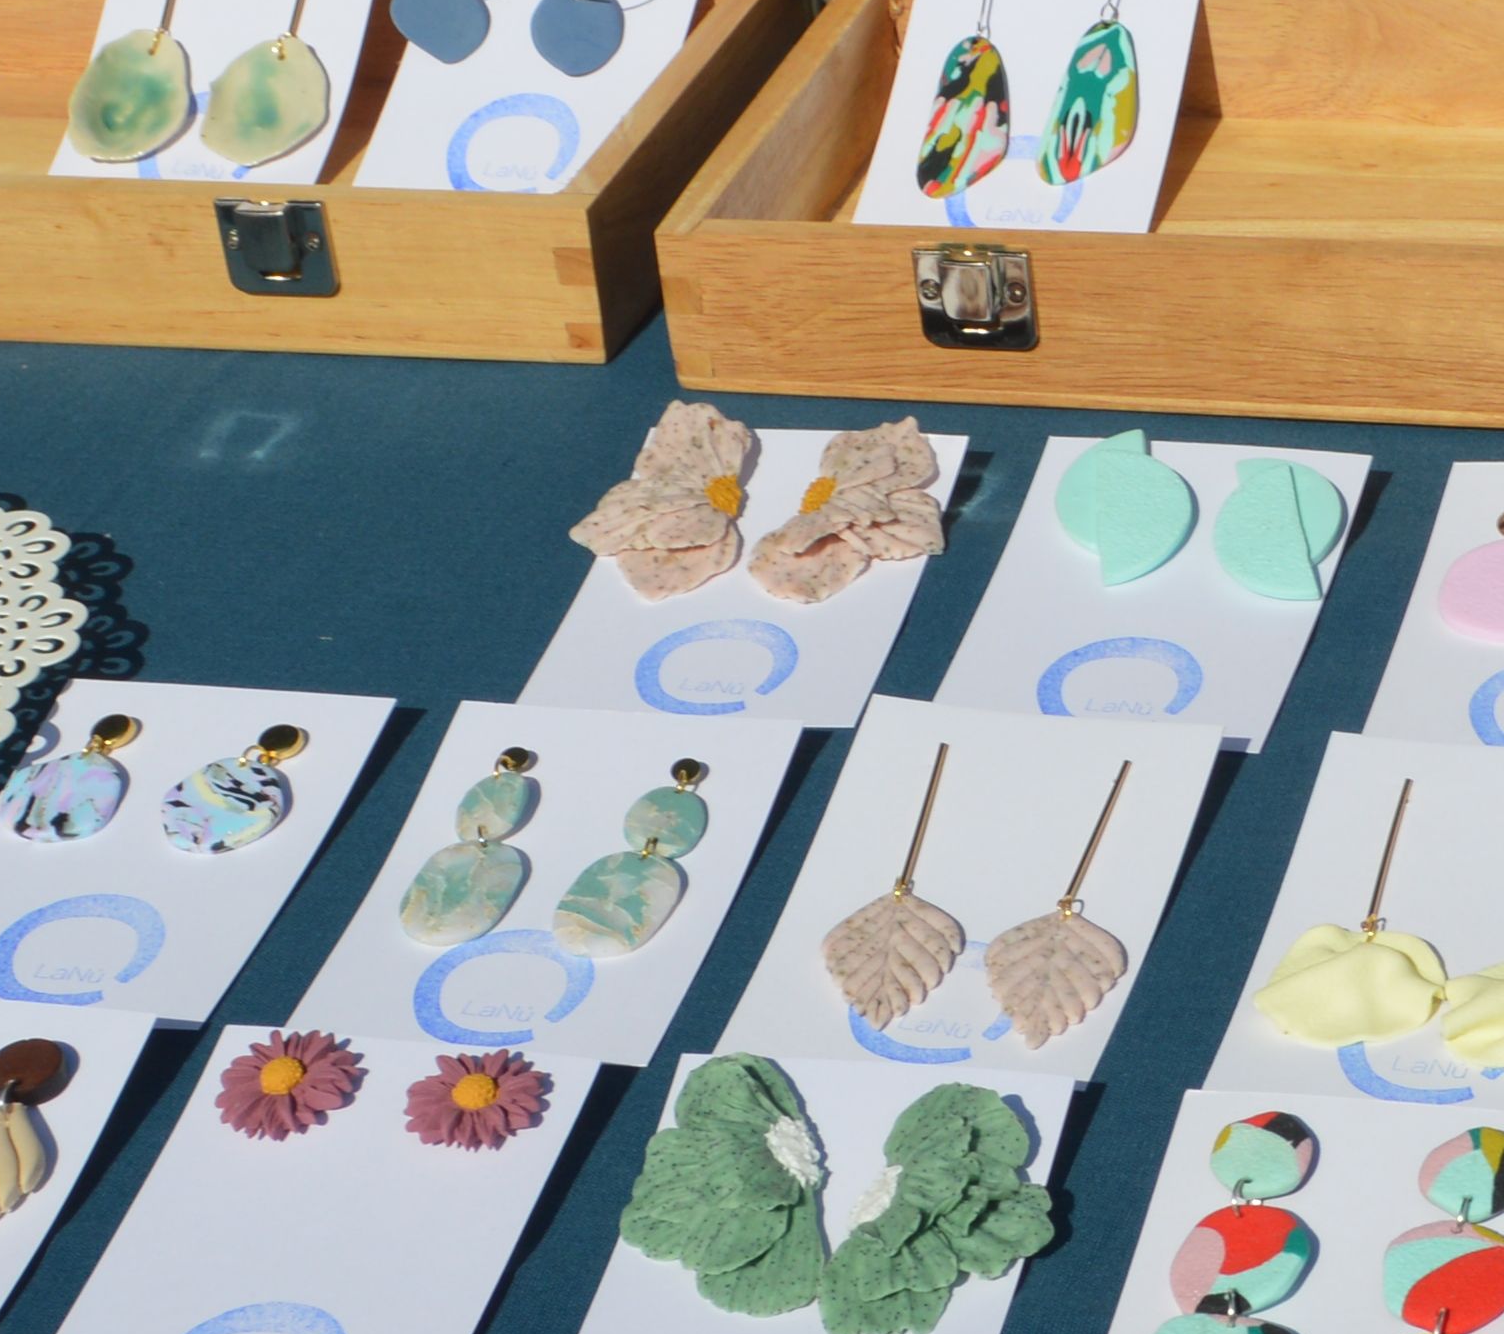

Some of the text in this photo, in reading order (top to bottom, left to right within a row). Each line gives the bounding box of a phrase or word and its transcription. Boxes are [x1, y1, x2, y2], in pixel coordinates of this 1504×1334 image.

[679, 678, 745, 696] LaNú
[1085, 698, 1151, 716] LaNú
[34, 963, 105, 984] LaNú
[462, 1000, 534, 1021] LaNú
[898, 1016, 972, 1039] LaNú
[1392, 1056, 1467, 1078] LaNú
